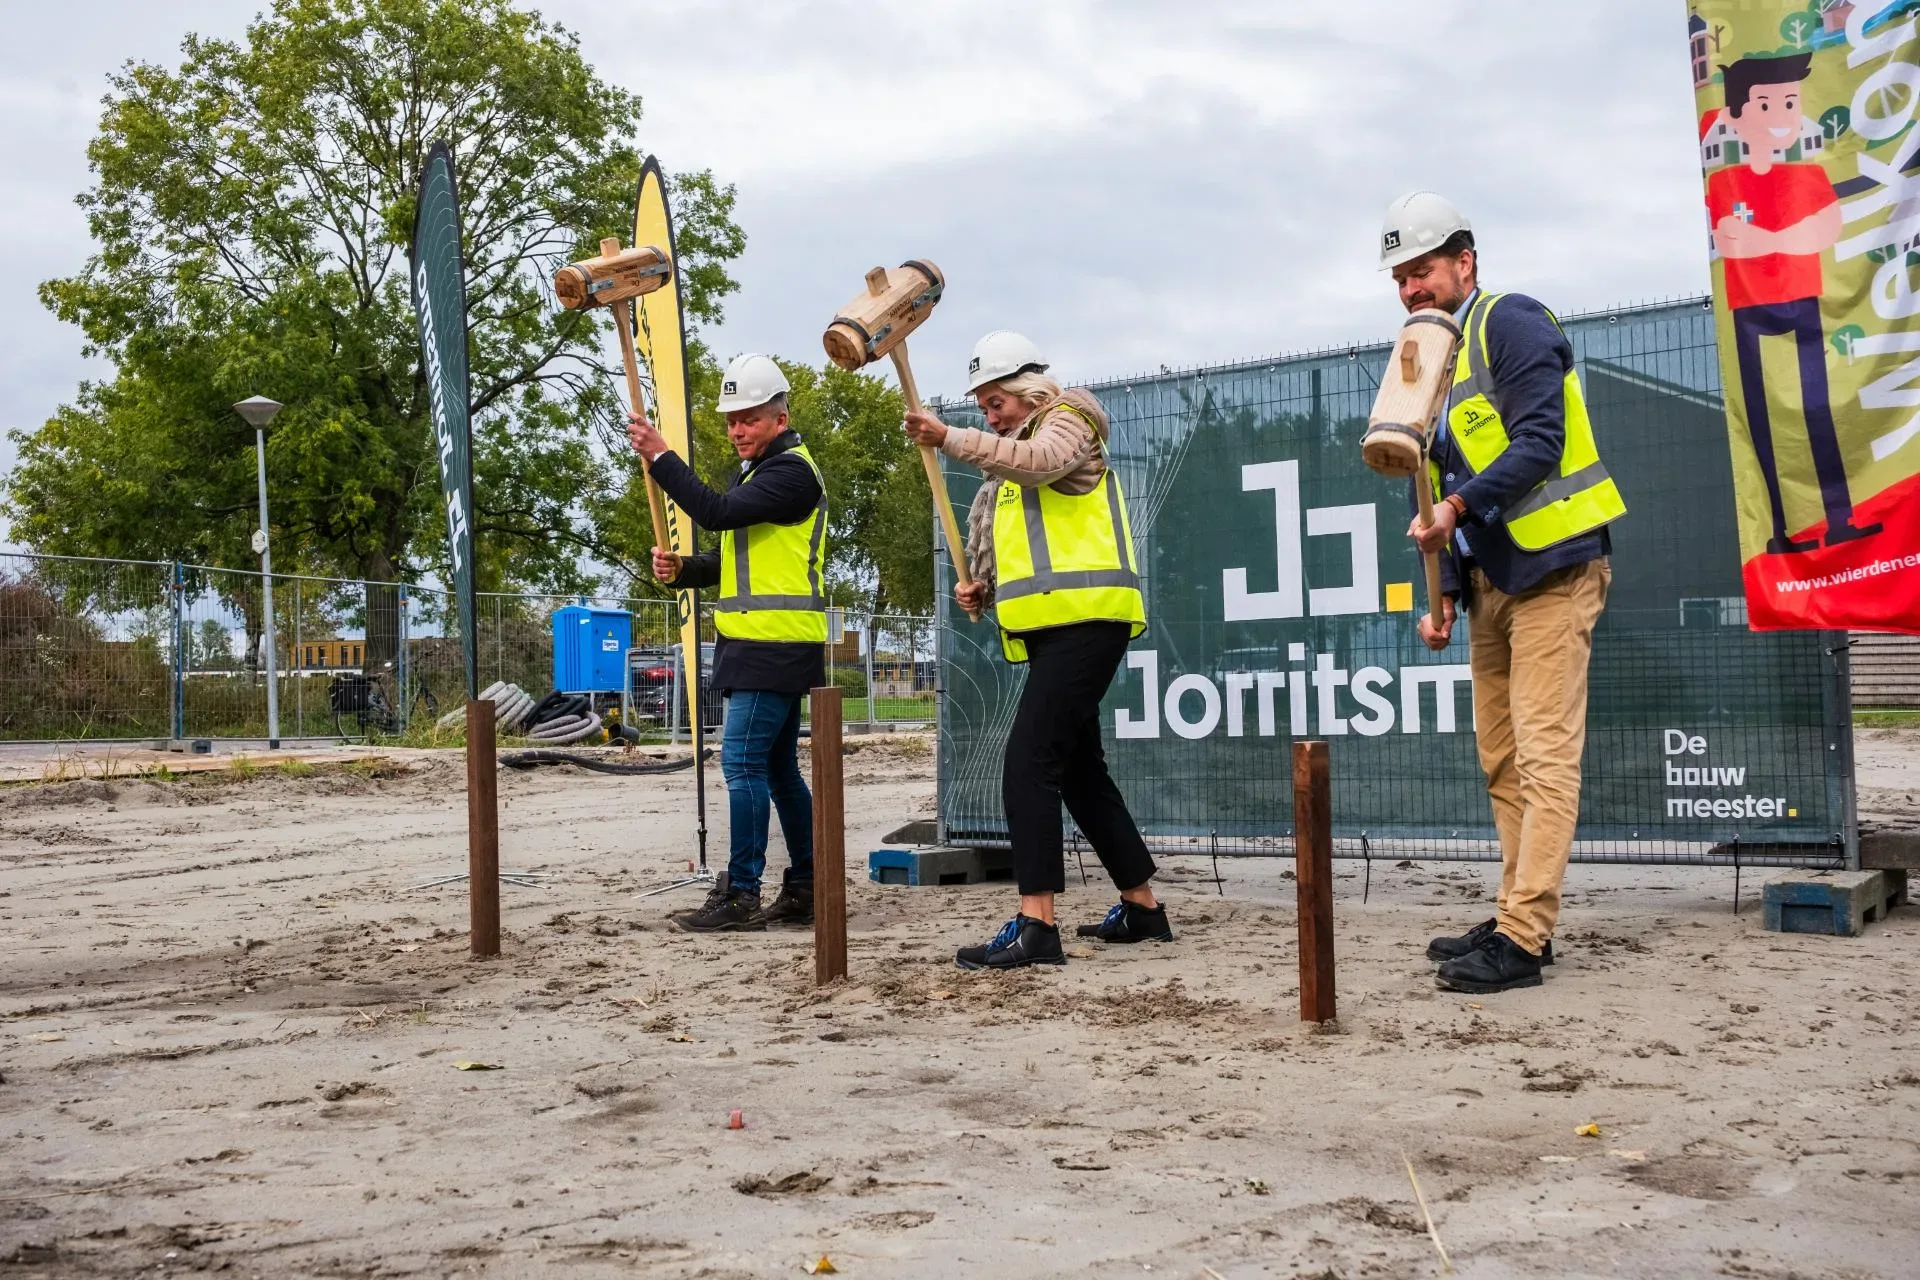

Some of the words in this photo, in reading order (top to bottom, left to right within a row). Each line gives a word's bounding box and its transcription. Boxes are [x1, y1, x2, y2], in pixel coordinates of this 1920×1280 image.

[1115, 642, 1476, 739] Jorritsm
[1664, 729, 1707, 755] De
[1666, 760, 1745, 786] bouw
[1667, 795, 1797, 818] meester.
